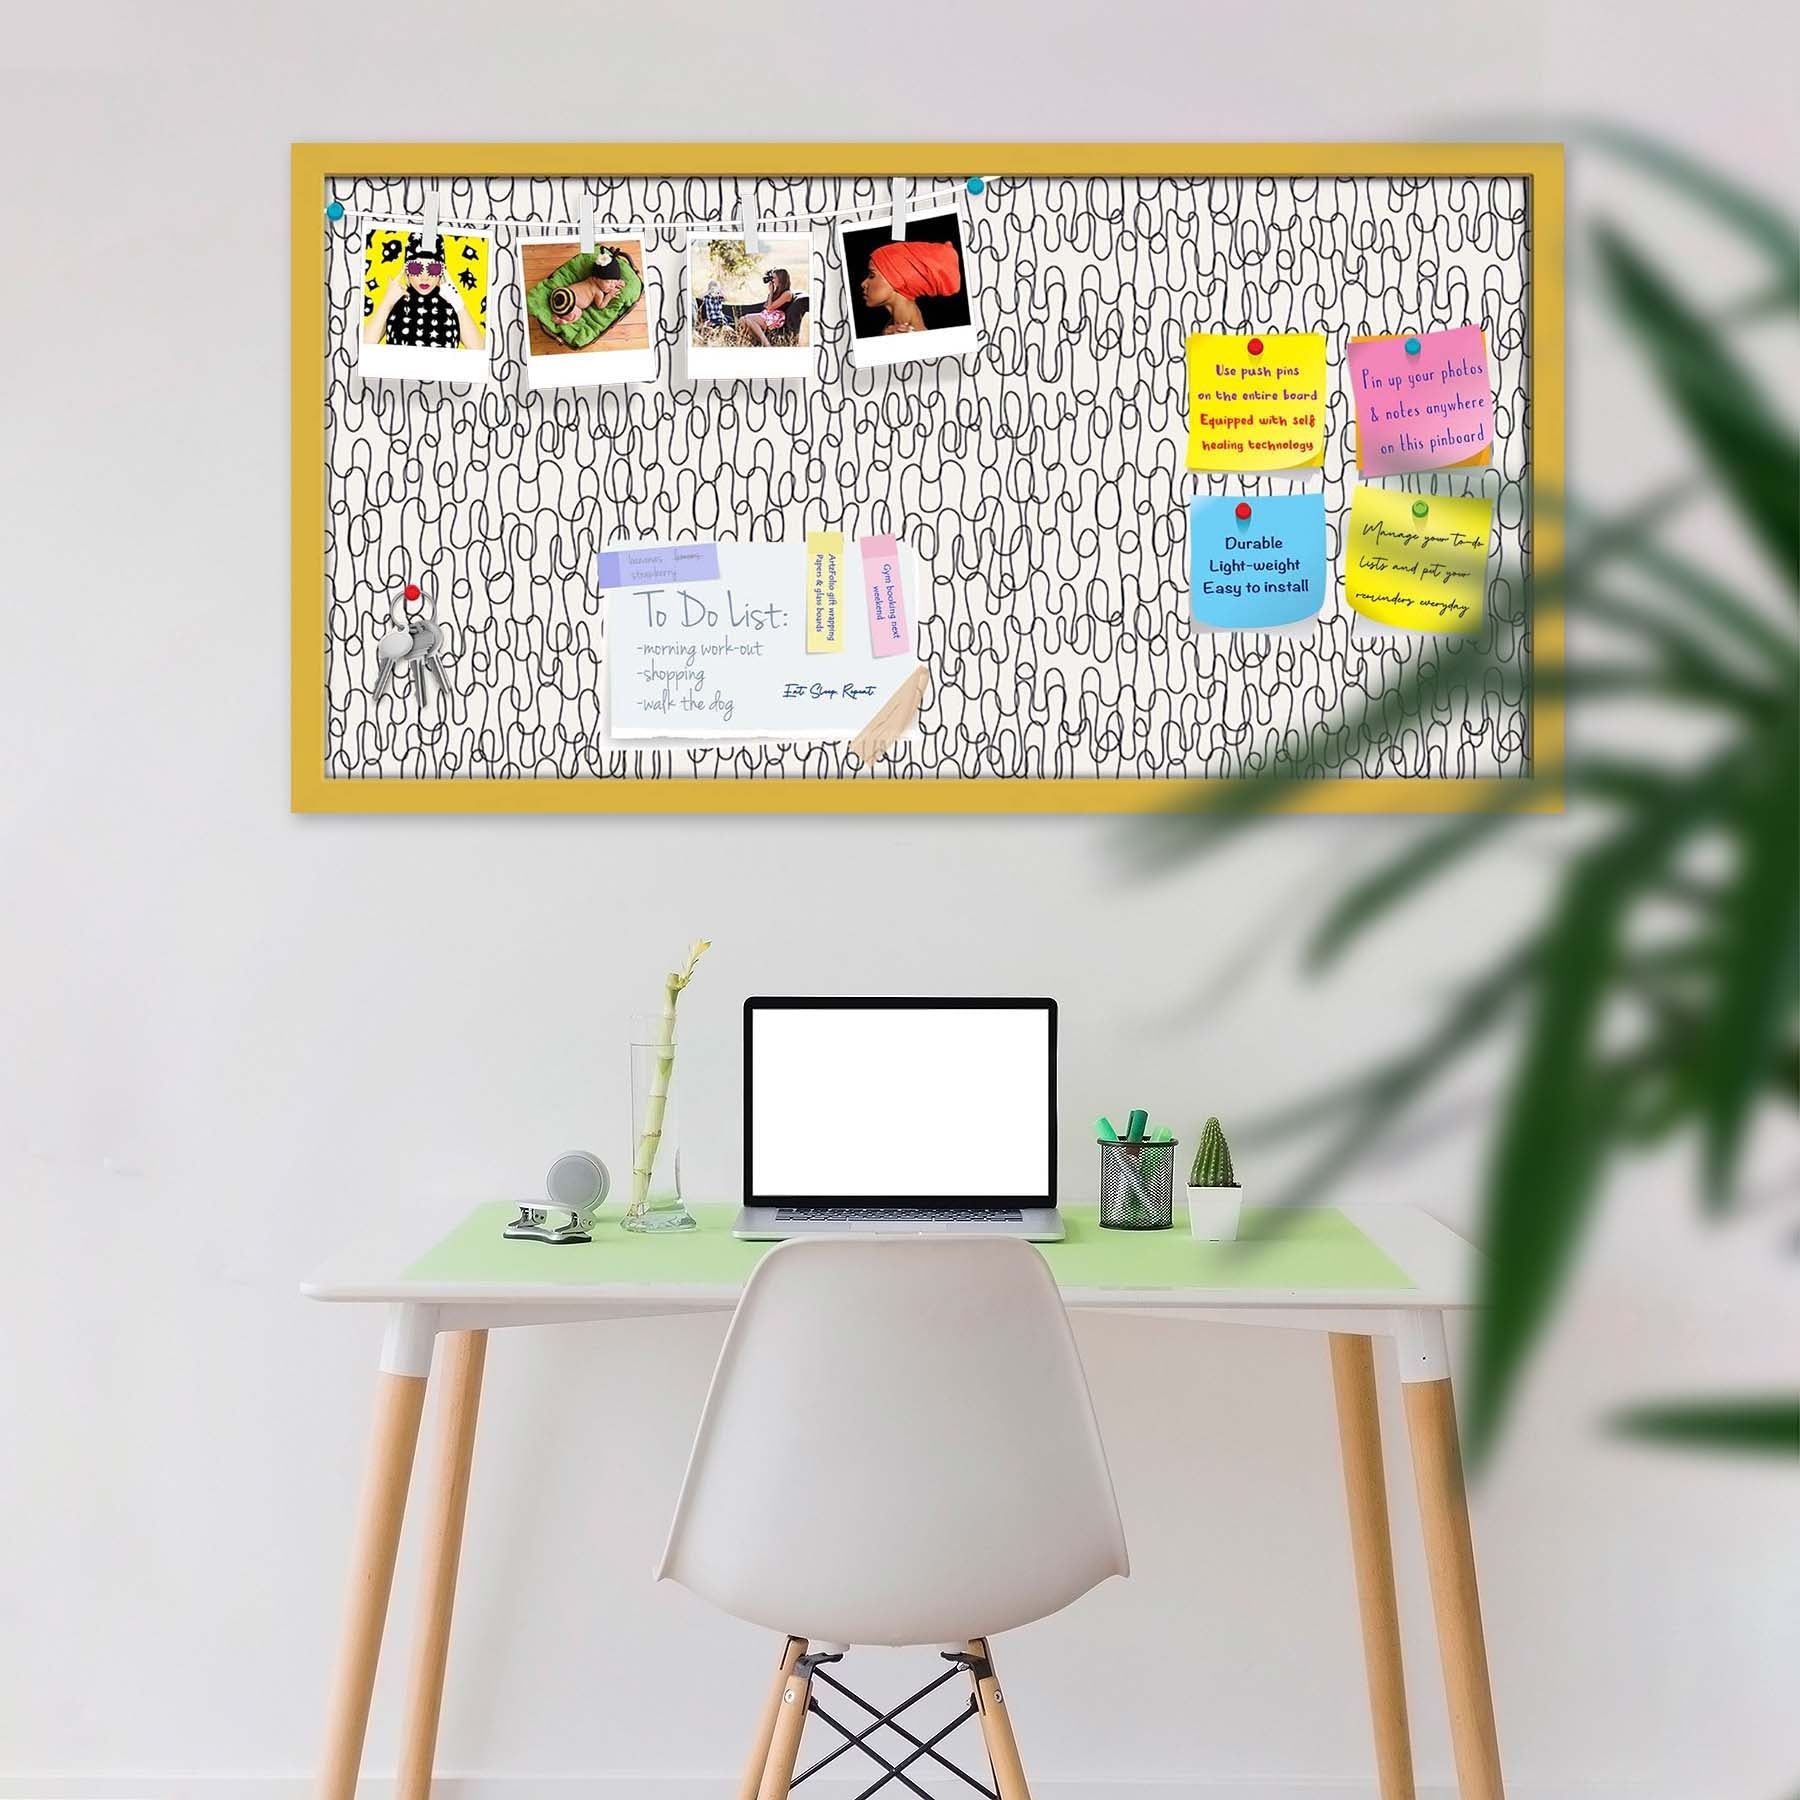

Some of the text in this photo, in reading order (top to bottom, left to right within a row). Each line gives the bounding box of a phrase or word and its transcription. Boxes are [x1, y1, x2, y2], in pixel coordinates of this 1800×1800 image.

[1215, 364, 1300, 380] Use push pins
[1362, 358, 1483, 391] Pin up your photos
[1215, 390, 1238, 401] the
[1242, 391, 1279, 401] entire
[1283, 388, 1318, 401] board
[1370, 392, 1485, 422] & notes anywhere
[1200, 413, 1316, 429] Equipped with self
[1202, 440, 1314, 453] healing technology
[1380, 423, 1485, 455] on this pinboard
[1225, 535, 1284, 551] Durable
[1362, 520, 1419, 546] Manage
[1420, 535, 1449, 549] your
[1209, 558, 1301, 576] Light-weight
[1392, 561, 1419, 576] and
[1419, 563, 1447, 581] put
[1445, 572, 1472, 584] your
[815, 579, 824, 587] &
[1203, 579, 1310, 598] Easy to install
[632, 589, 789, 631] To Do List:
[814, 588, 825, 606] glass
[826, 592, 838, 606] gift
[873, 585, 886, 621] weekend
[881, 563, 901, 639] Gym booking next
[1355, 592, 1470, 618] reminders everyday
[815, 607, 825, 633] boards
[827, 607, 836, 641] wrapping
[636, 634, 765, 667] -morning work-out
[636, 657, 705, 692] -shopping
[782, 683, 808, 698] Eat
[636, 687, 735, 721] -walk the dog
